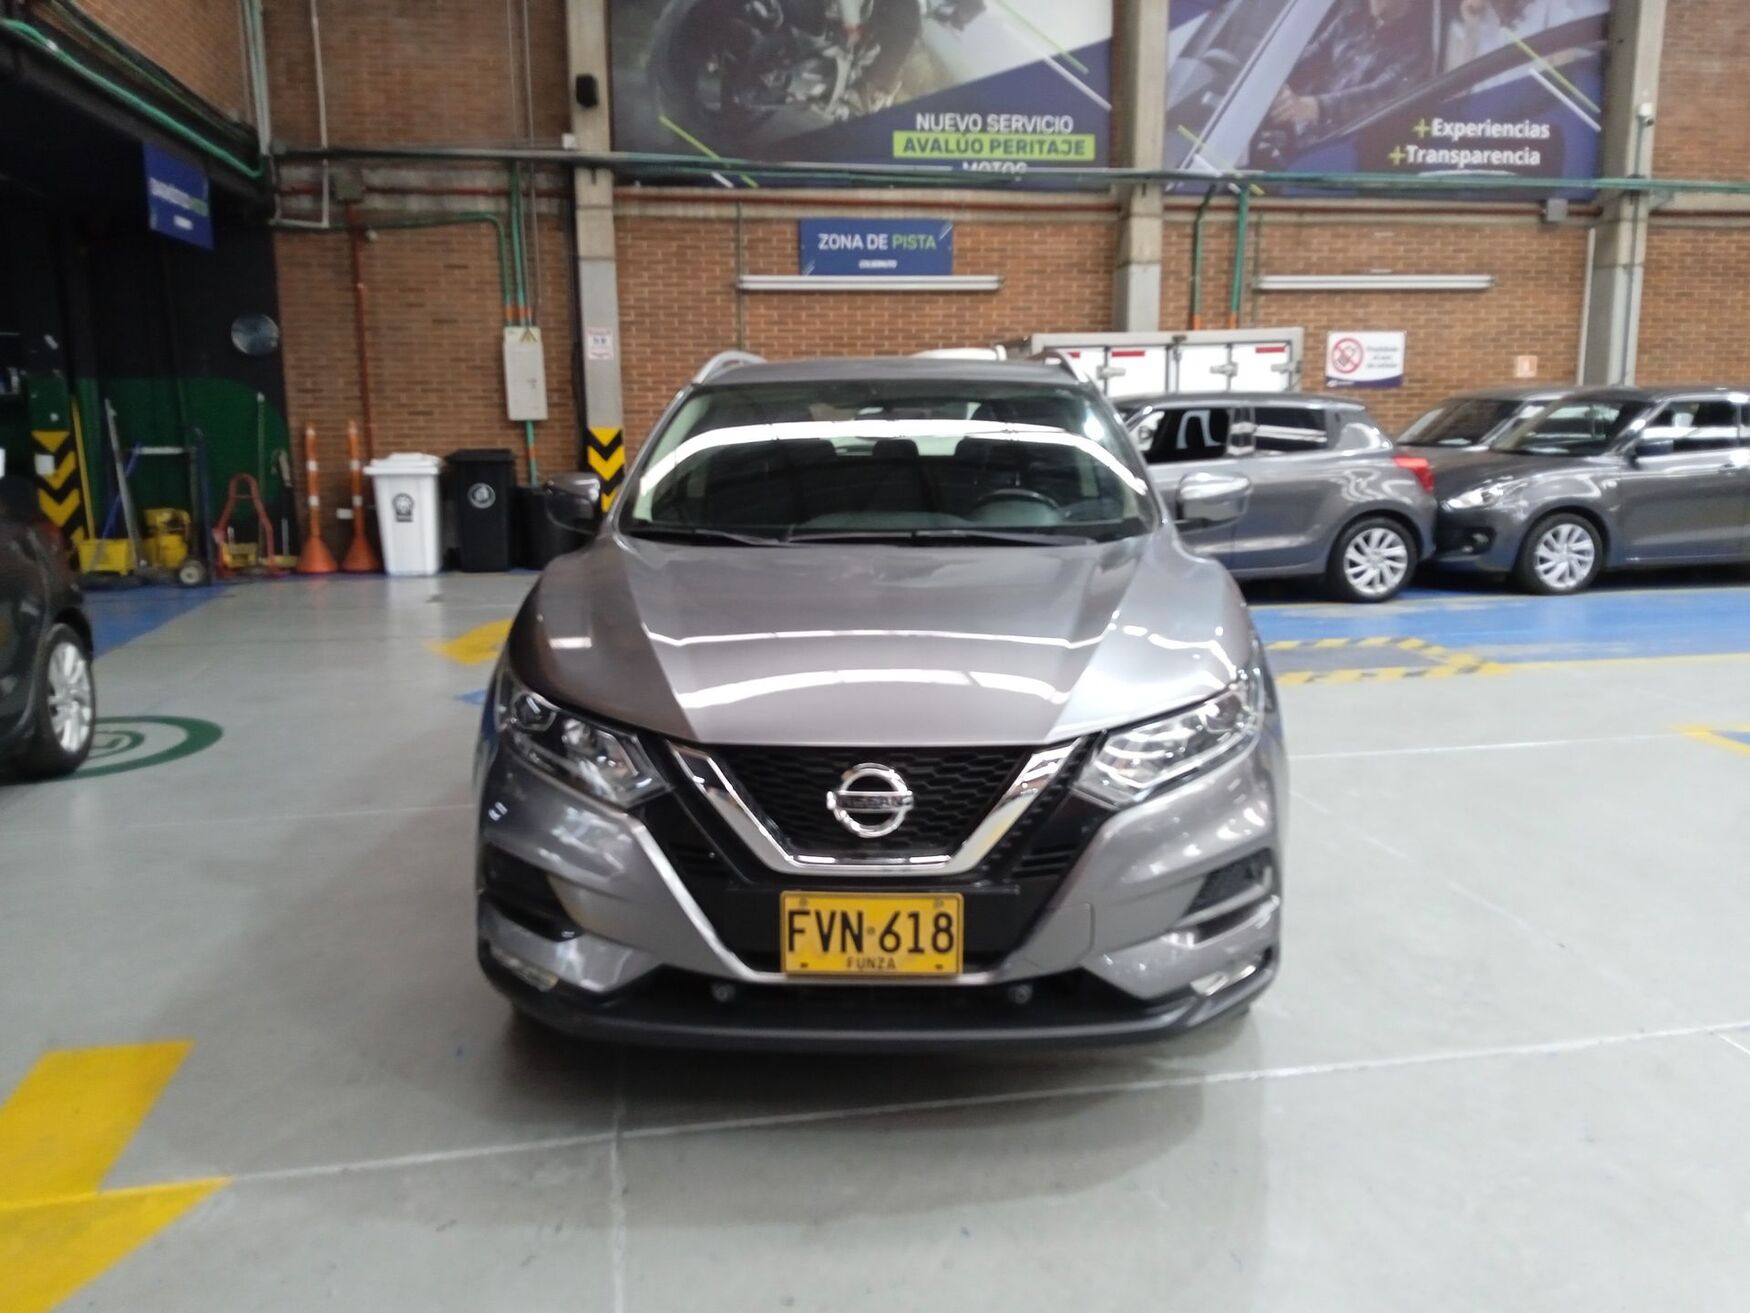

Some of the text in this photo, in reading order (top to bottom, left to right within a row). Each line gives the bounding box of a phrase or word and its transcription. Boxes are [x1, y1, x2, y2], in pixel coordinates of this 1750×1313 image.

[916, 113, 1074, 134] NUEVO SERVICIO
[1412, 118, 1550, 142] +Experiencias
[903, 134, 1086, 156] AVALÚO PERITAJE
[1387, 144, 1541, 168] +Transparencia
[818, 233, 937, 250] ZONA DE PISTA
[846, 957, 897, 970] FUNZA
